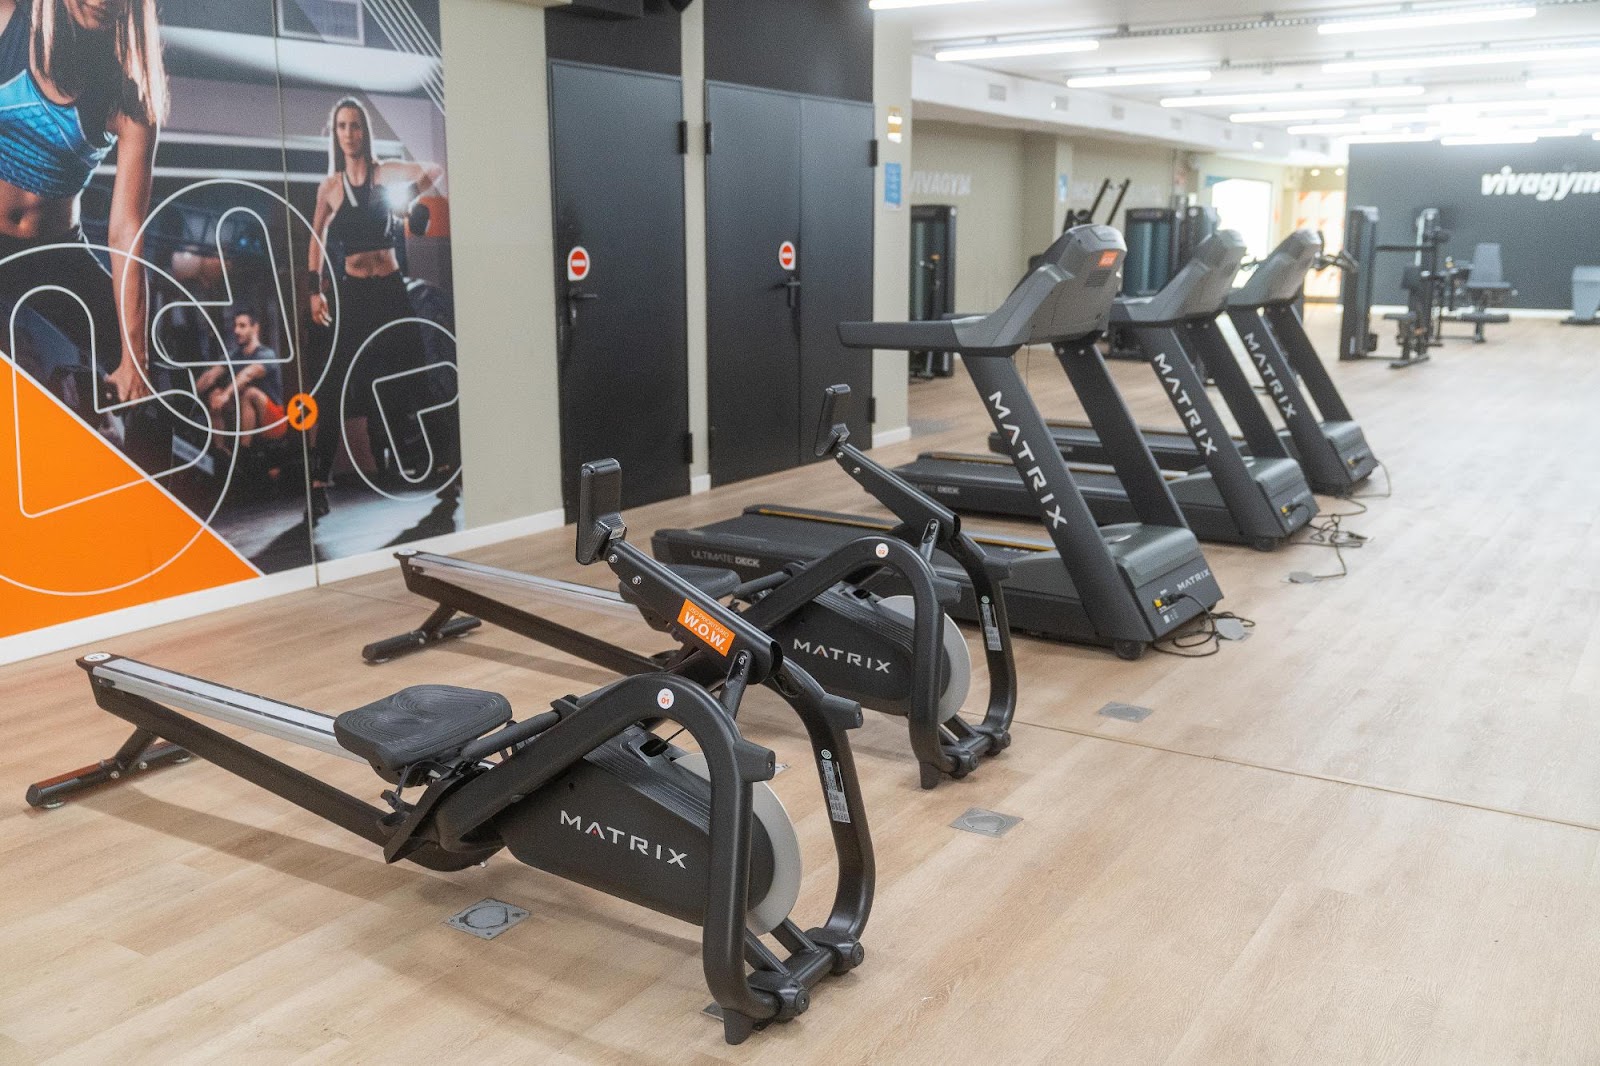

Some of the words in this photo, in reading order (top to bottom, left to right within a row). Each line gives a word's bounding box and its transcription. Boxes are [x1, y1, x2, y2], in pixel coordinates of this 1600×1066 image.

[1481, 165, 1600, 201] vivagym
[1244, 332, 1297, 419] MATRIX
[1153, 353, 1218, 456] MATRIX
[988, 391, 1068, 529] MATRIX
[1176, 568, 1211, 591] MATRIX
[684, 611, 726, 650] W.O.W.
[793, 637, 891, 674] MATRIX
[560, 809, 688, 870] MATRIX
